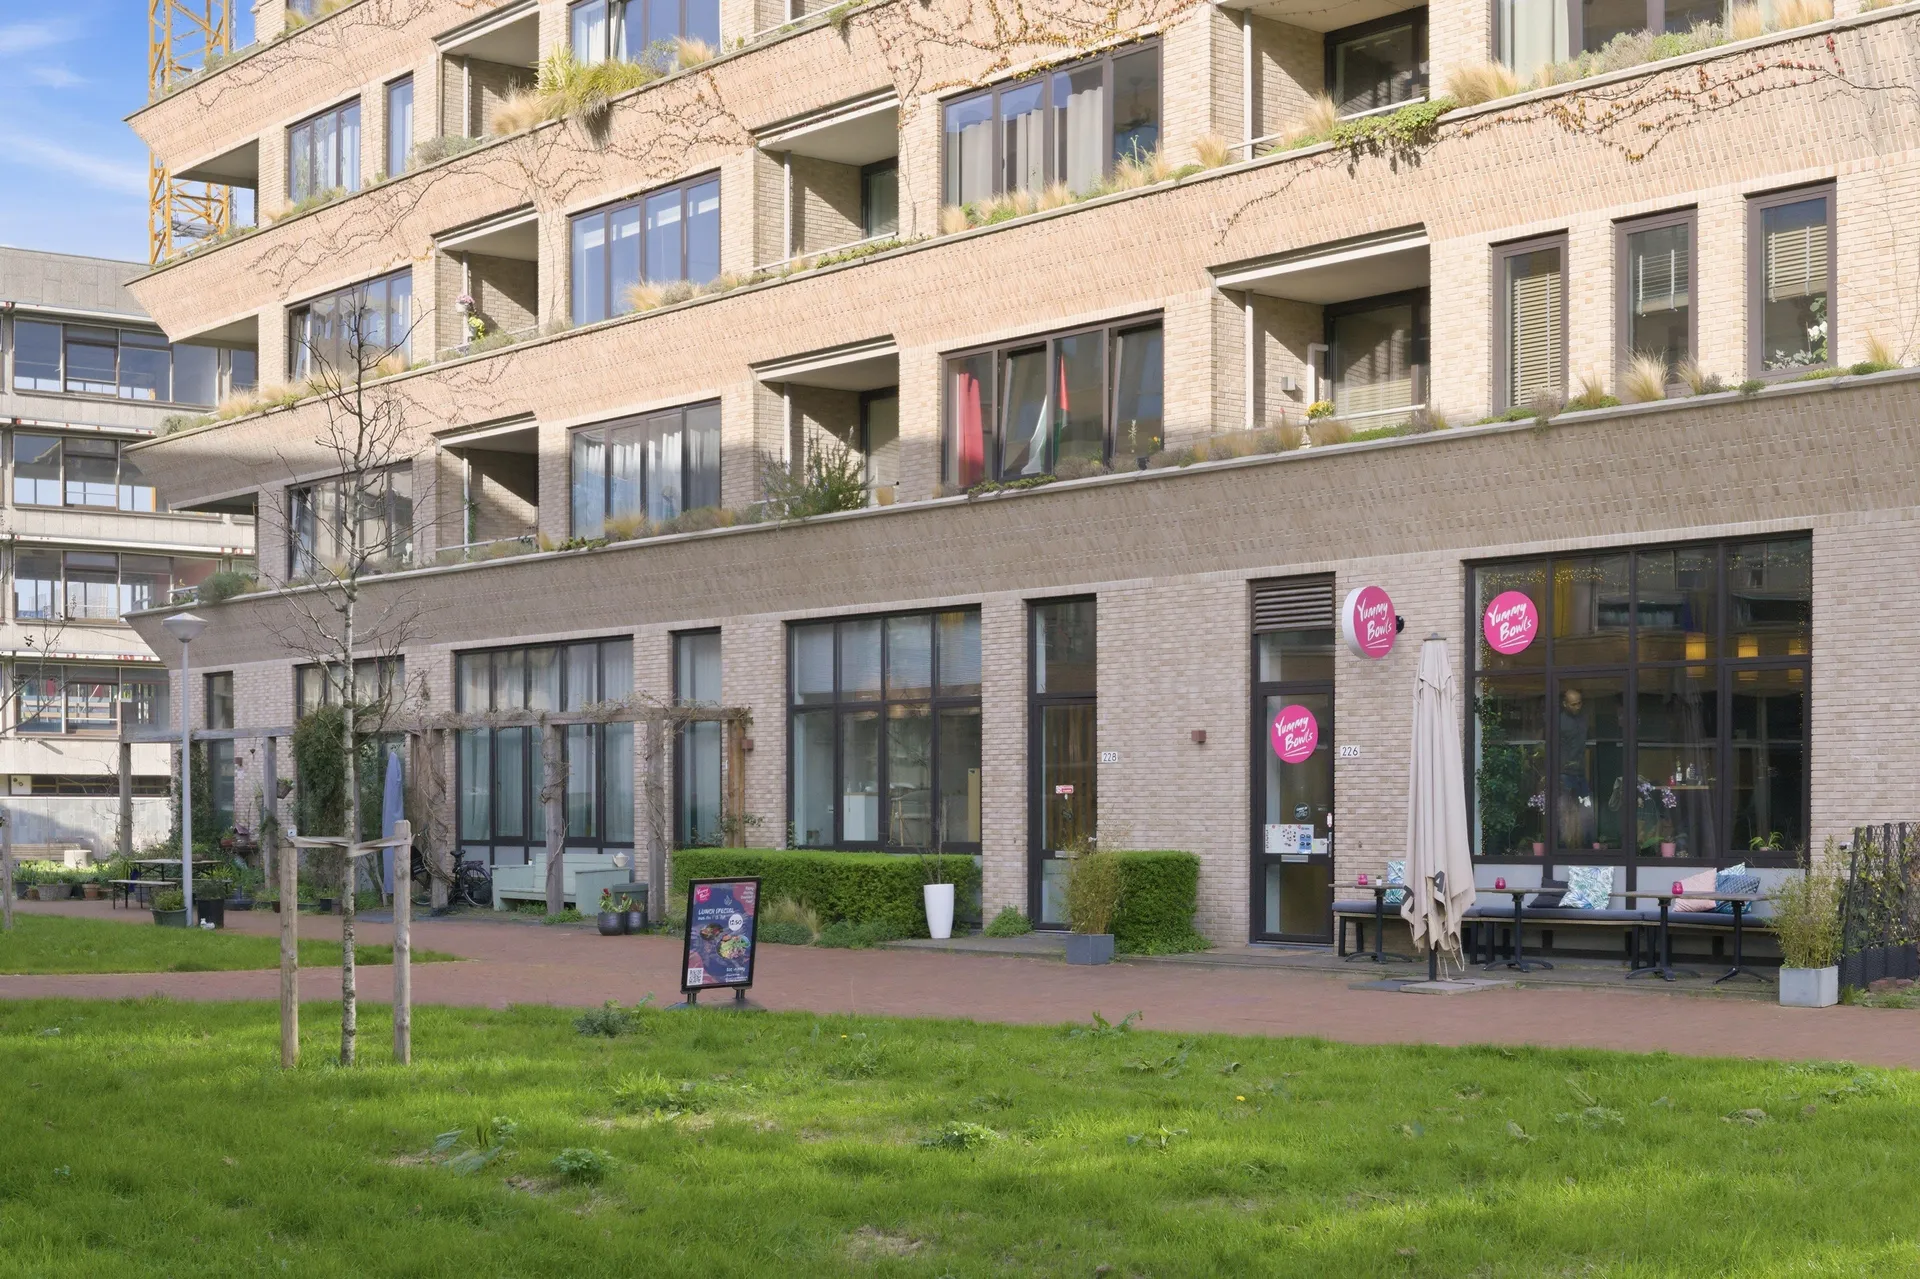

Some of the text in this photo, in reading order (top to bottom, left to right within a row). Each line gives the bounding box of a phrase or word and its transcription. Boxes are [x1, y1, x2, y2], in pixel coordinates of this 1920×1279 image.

[1357, 598, 1388, 622] Yummy
[1488, 602, 1527, 626] Yummy
[1367, 616, 1392, 641] Bowls
[1499, 616, 1532, 642] Bowls
[1275, 716, 1309, 737] Yummy
[1284, 729, 1313, 751] Bowls
[1342, 746, 1359, 757] 226
[1103, 752, 1117, 762] 228
